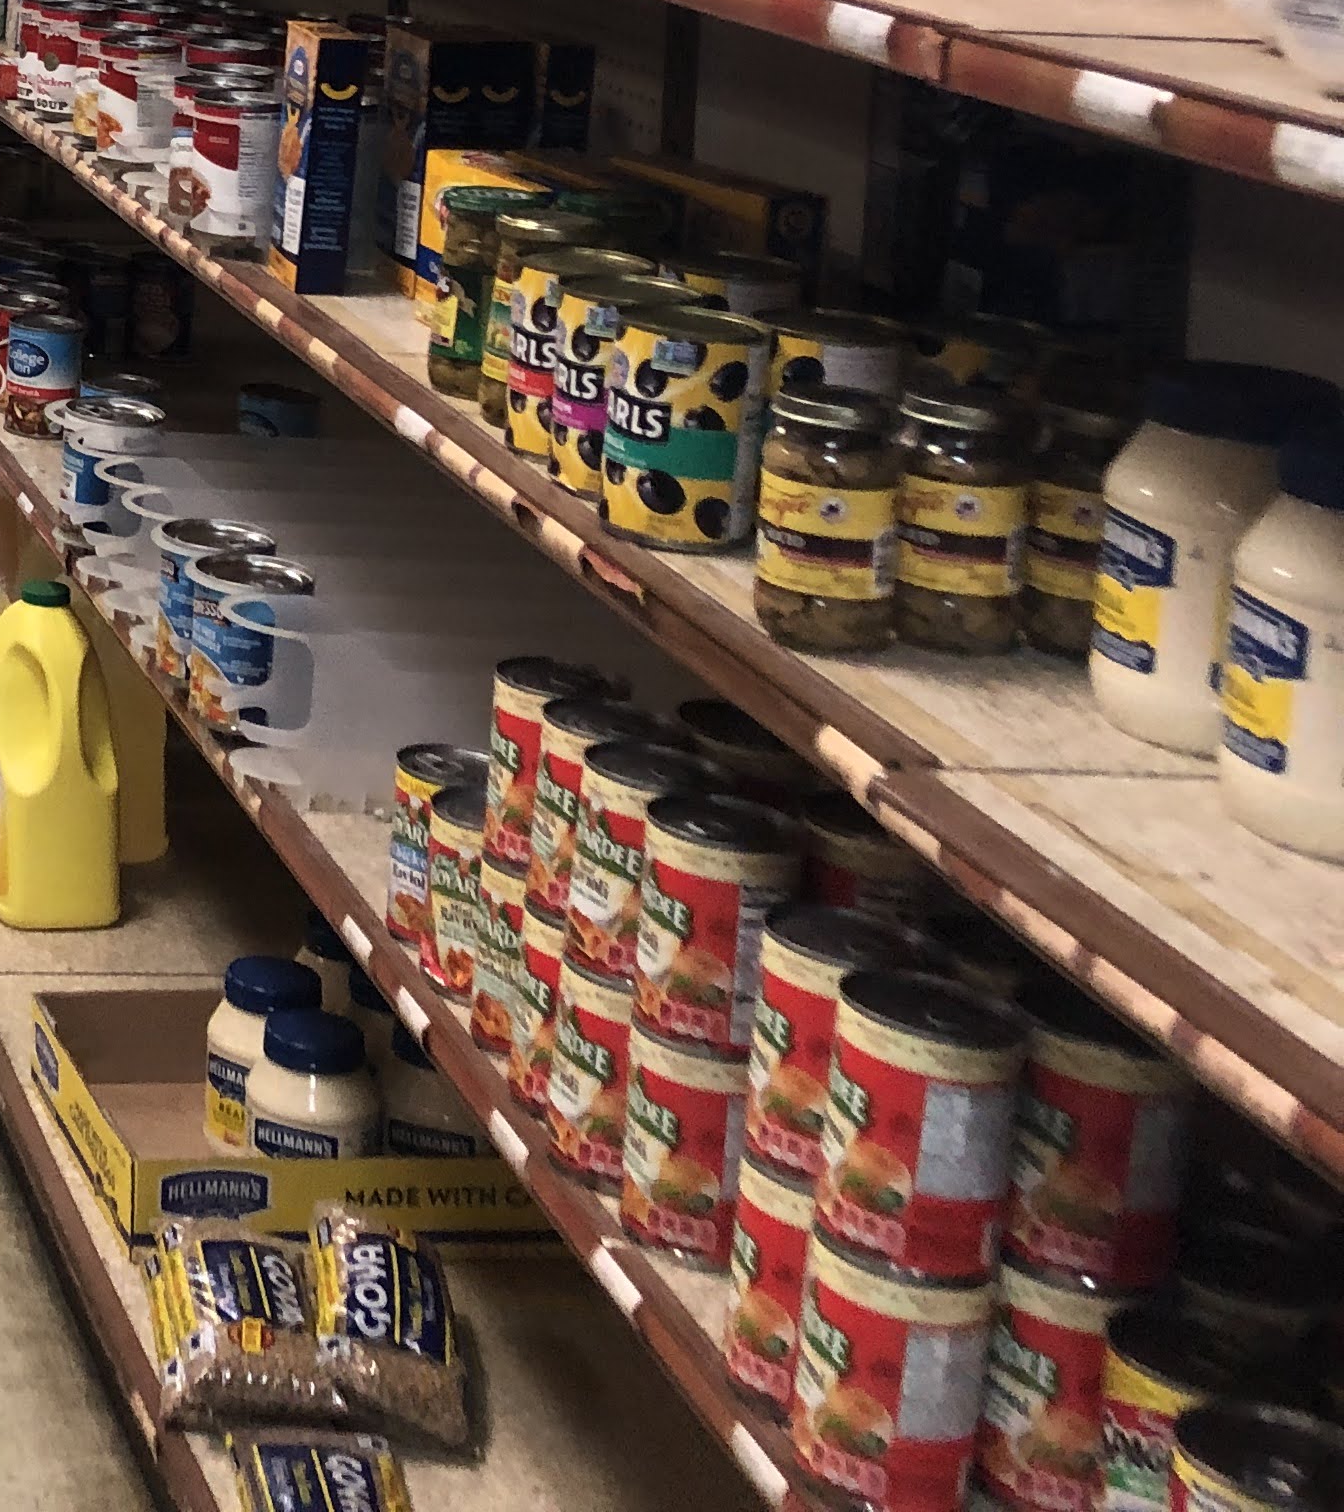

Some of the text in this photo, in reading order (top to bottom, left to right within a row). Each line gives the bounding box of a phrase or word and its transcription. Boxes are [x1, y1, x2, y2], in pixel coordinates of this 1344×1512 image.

[35, 97, 69, 111] SOUP
[168, 1178, 262, 1202] HELLMANN'S
[344, 1187, 419, 1208] MADE
[427, 1187, 498, 1208] WITH
[351, 1244, 387, 1338] GOYA
